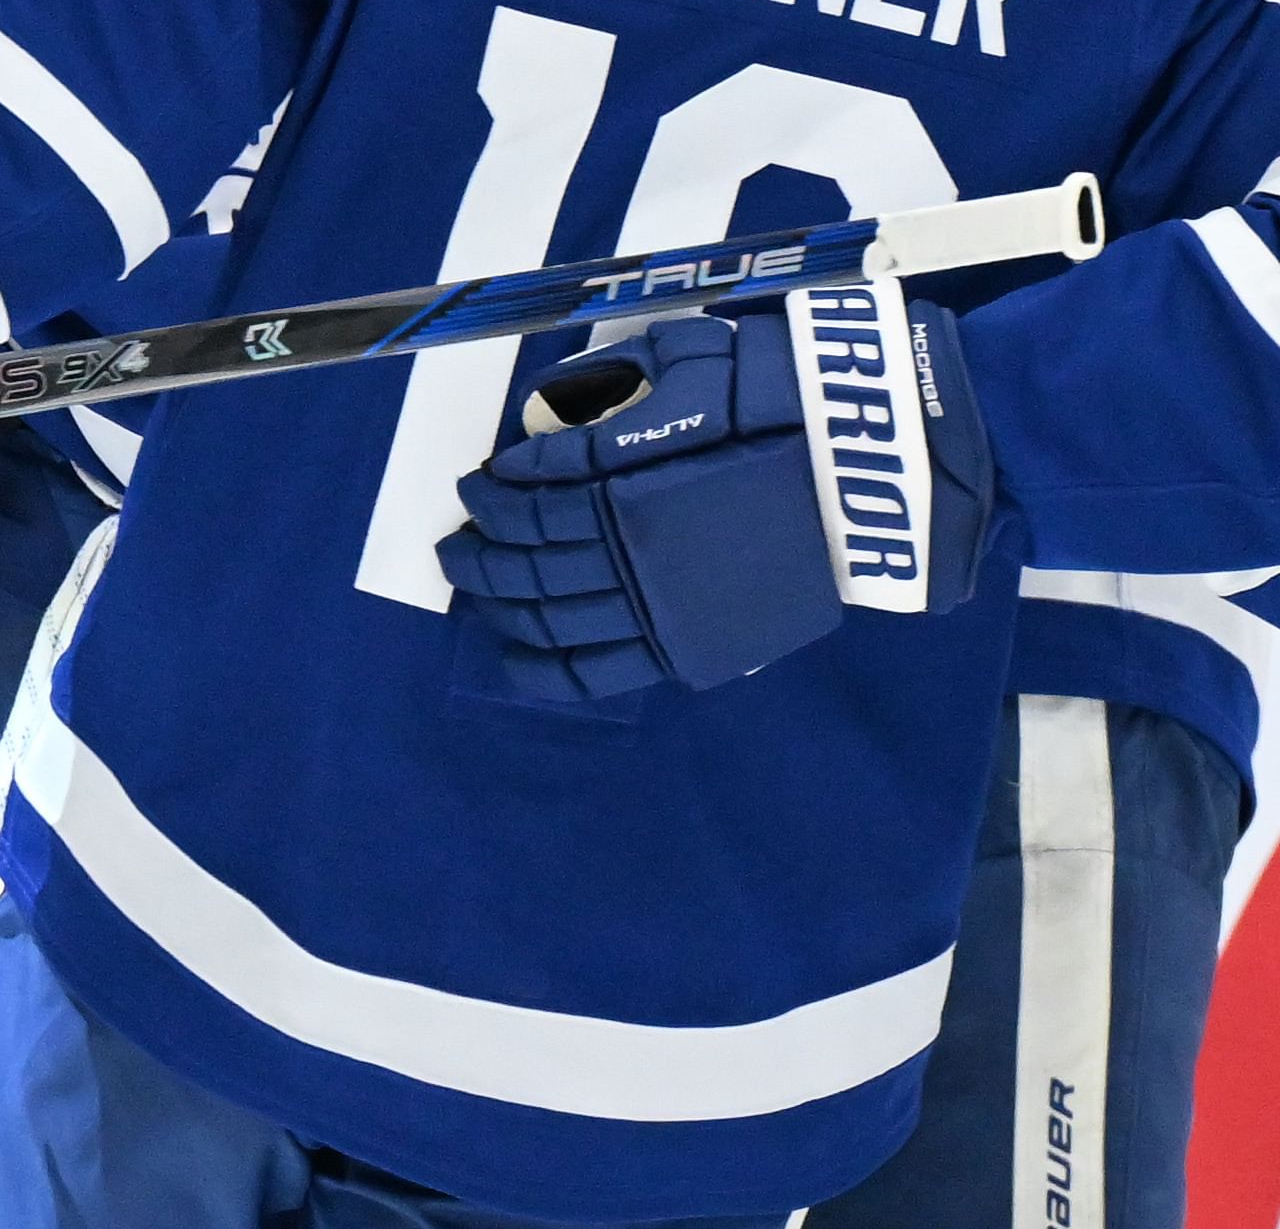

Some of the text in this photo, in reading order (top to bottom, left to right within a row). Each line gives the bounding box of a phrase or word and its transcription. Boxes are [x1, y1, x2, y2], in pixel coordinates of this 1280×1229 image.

[582, 245, 808, 301] TRUE
[616, 412, 706, 448] ALPHA
[808, 288, 918, 581] ARRIOR
